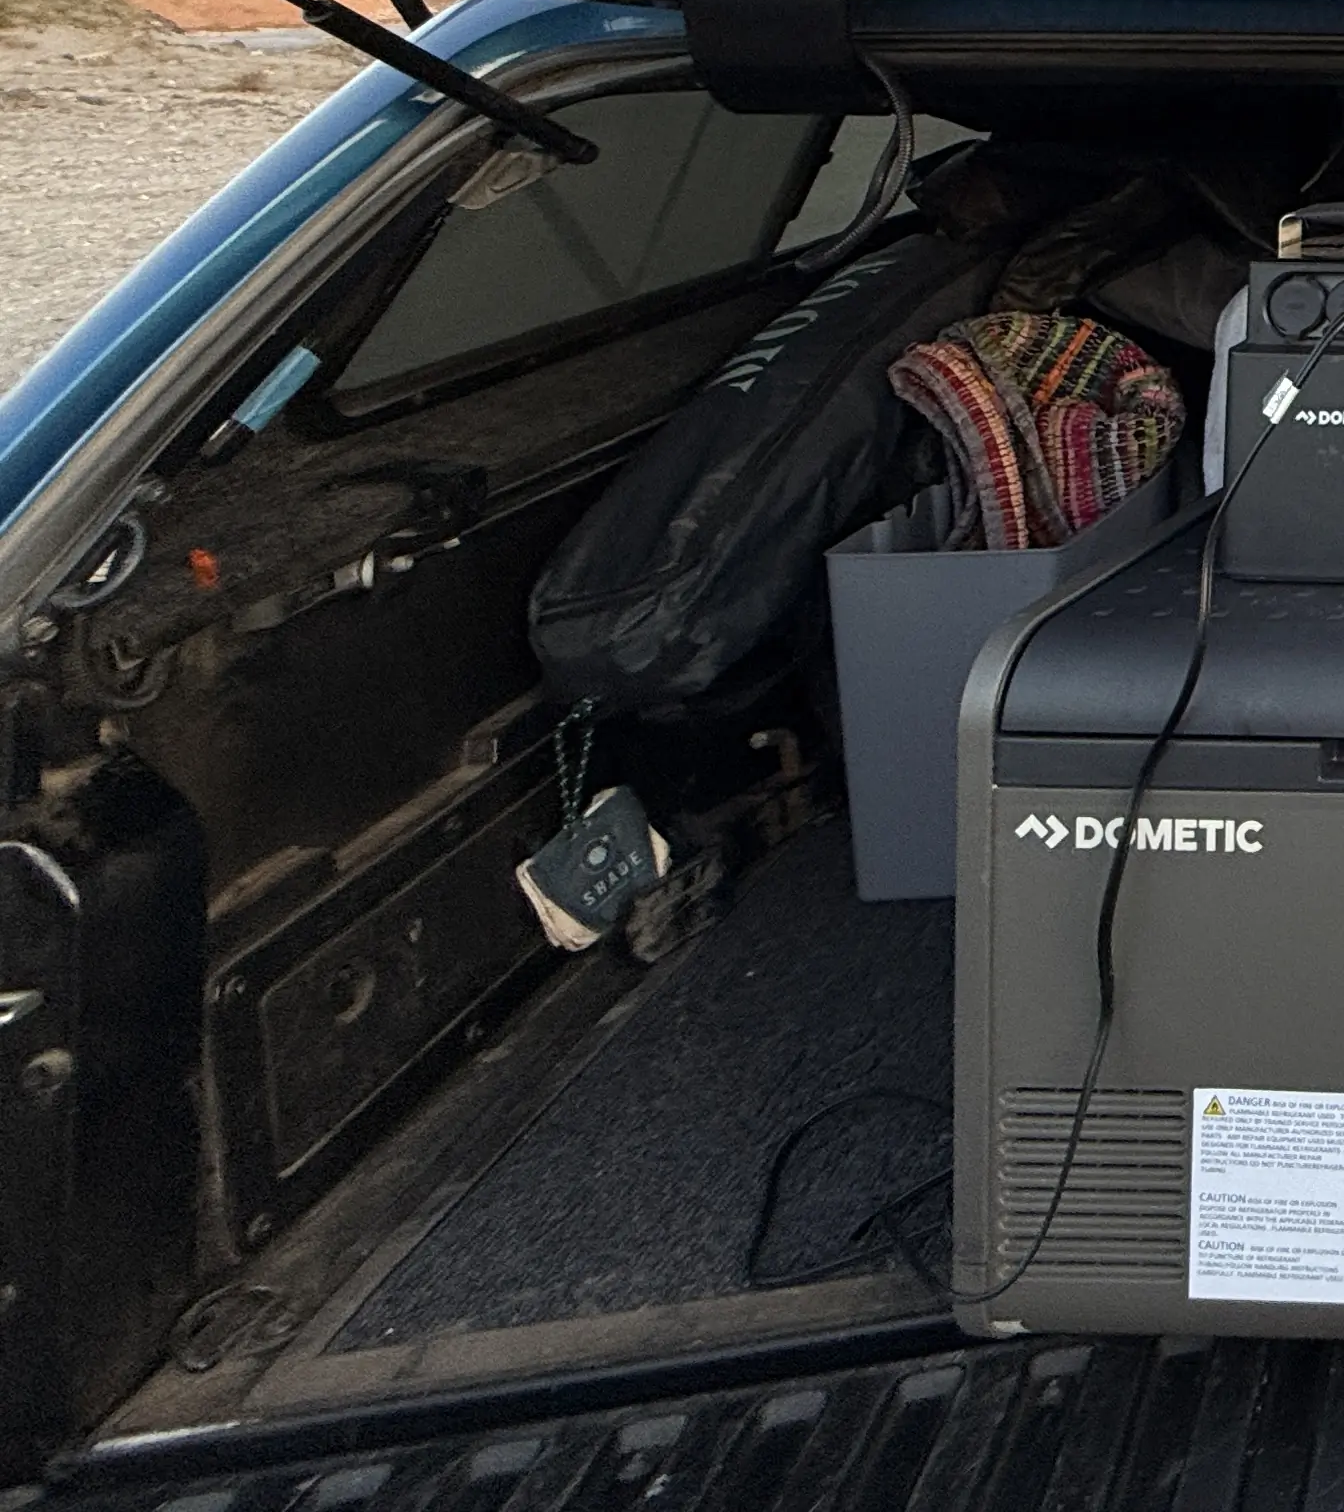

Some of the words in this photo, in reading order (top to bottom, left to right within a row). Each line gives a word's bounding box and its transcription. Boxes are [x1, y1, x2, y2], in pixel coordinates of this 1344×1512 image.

[1075, 816, 1264, 854] DOMETIC
[583, 851, 643, 906] SHADE
[1229, 1097, 1270, 1106] DANGER
[1199, 1193, 1246, 1203] CAUTION
[1198, 1241, 1244, 1251] CAUTION
